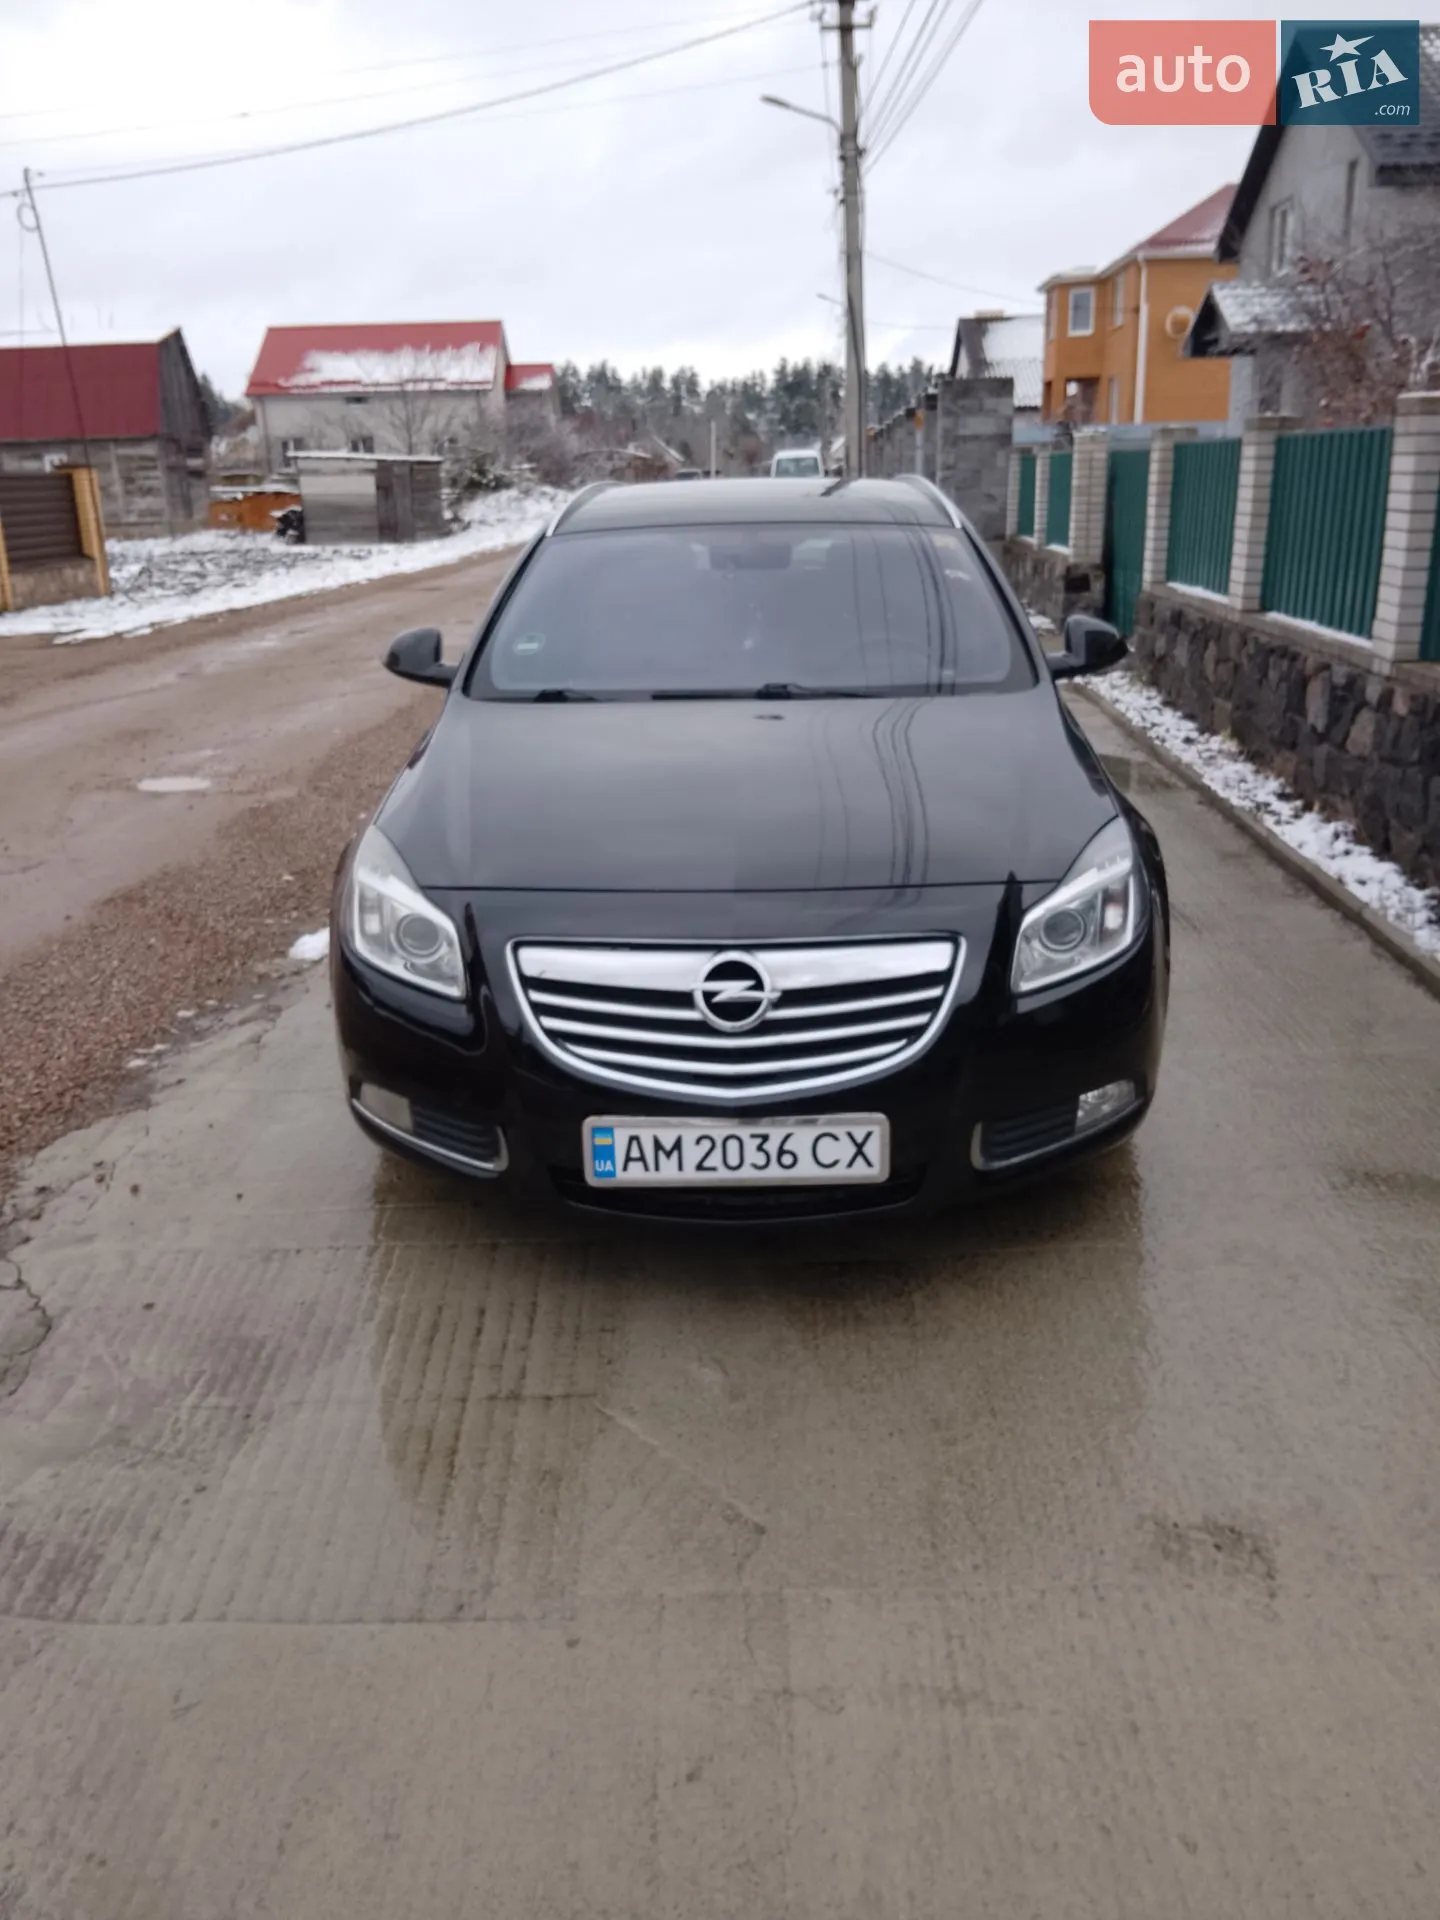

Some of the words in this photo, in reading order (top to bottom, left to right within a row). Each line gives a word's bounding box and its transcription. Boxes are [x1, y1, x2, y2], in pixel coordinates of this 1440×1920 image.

[622, 1134, 684, 1172] AM
[694, 1133, 798, 1171] 2036
[812, 1131, 874, 1169] CX
[594, 1160, 614, 1172] UA
